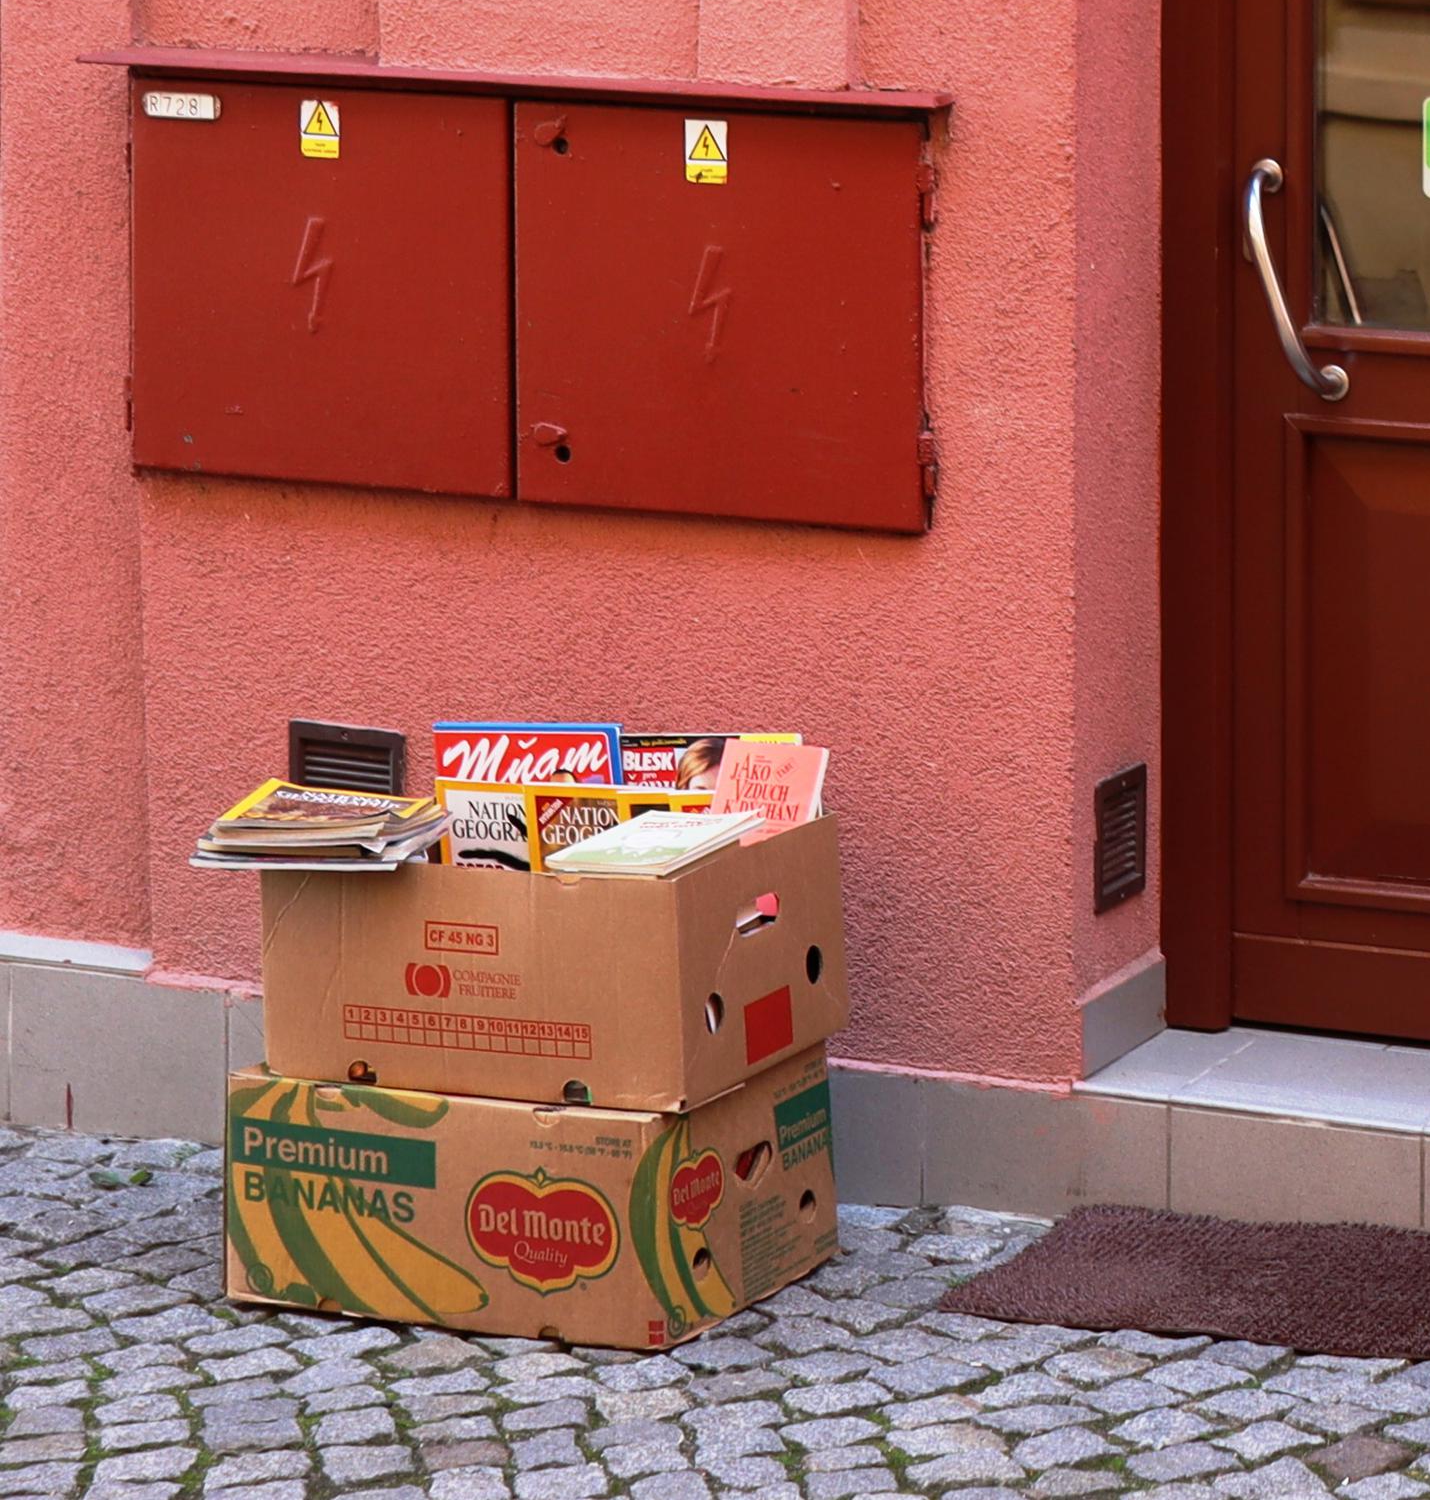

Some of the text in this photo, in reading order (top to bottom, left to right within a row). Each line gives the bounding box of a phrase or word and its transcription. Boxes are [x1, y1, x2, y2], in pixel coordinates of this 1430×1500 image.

[443, 734, 608, 784] Mňam
[622, 750, 674, 772] BLESK
[730, 753, 772, 782] JAKO
[735, 779, 790, 803] VZDUCH
[429, 930, 494, 947] CF 45 NG 3
[453, 969, 521, 987] COMPAGNIE
[458, 984, 517, 1000] FRUITIERE
[348, 1009, 588, 1040] 1 2 3 4 5 6 7 8 9 10 11 12 13 14 15
[244, 1126, 388, 1175] Premium
[244, 1171, 415, 1224] BANANAS
[477, 1202, 607, 1247] Del Monte
[513, 1239, 570, 1269] Quality
